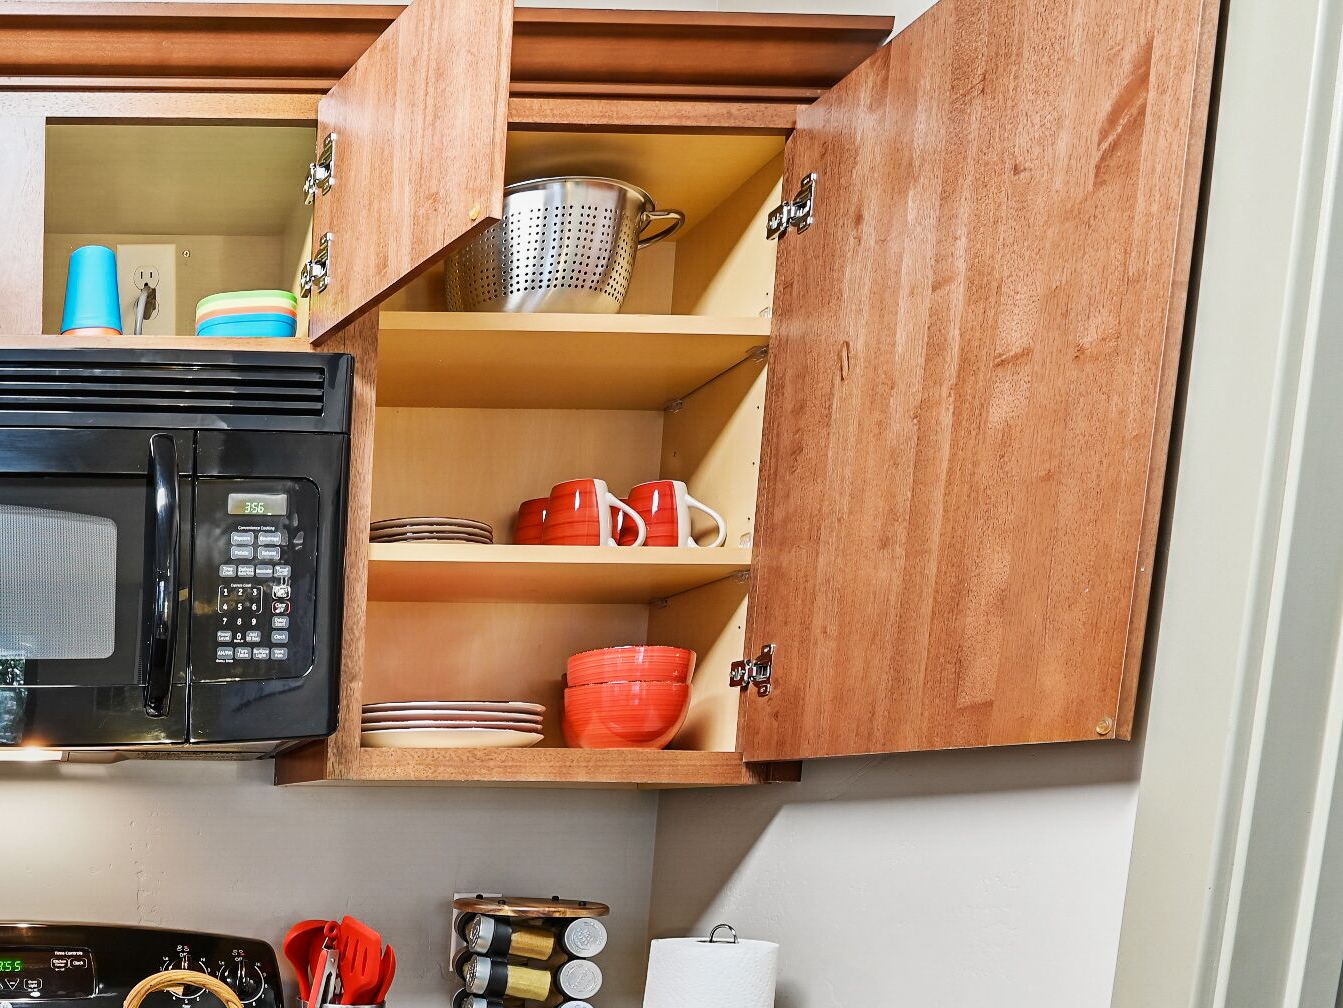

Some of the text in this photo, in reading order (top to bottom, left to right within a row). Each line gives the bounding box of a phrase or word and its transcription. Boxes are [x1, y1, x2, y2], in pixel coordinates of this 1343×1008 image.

[244, 502, 265, 513] 3:56
[223, 588, 228, 596] 1
[237, 588, 243, 596] 2
[252, 588, 258, 596] 3
[222, 603, 228, 611] 4
[237, 603, 243, 611] 5
[251, 603, 257, 611] 6
[222, 617, 228, 625] 7
[236, 617, 242, 625] 8
[251, 617, 257, 626] 9
[236, 632, 242, 640] 0
